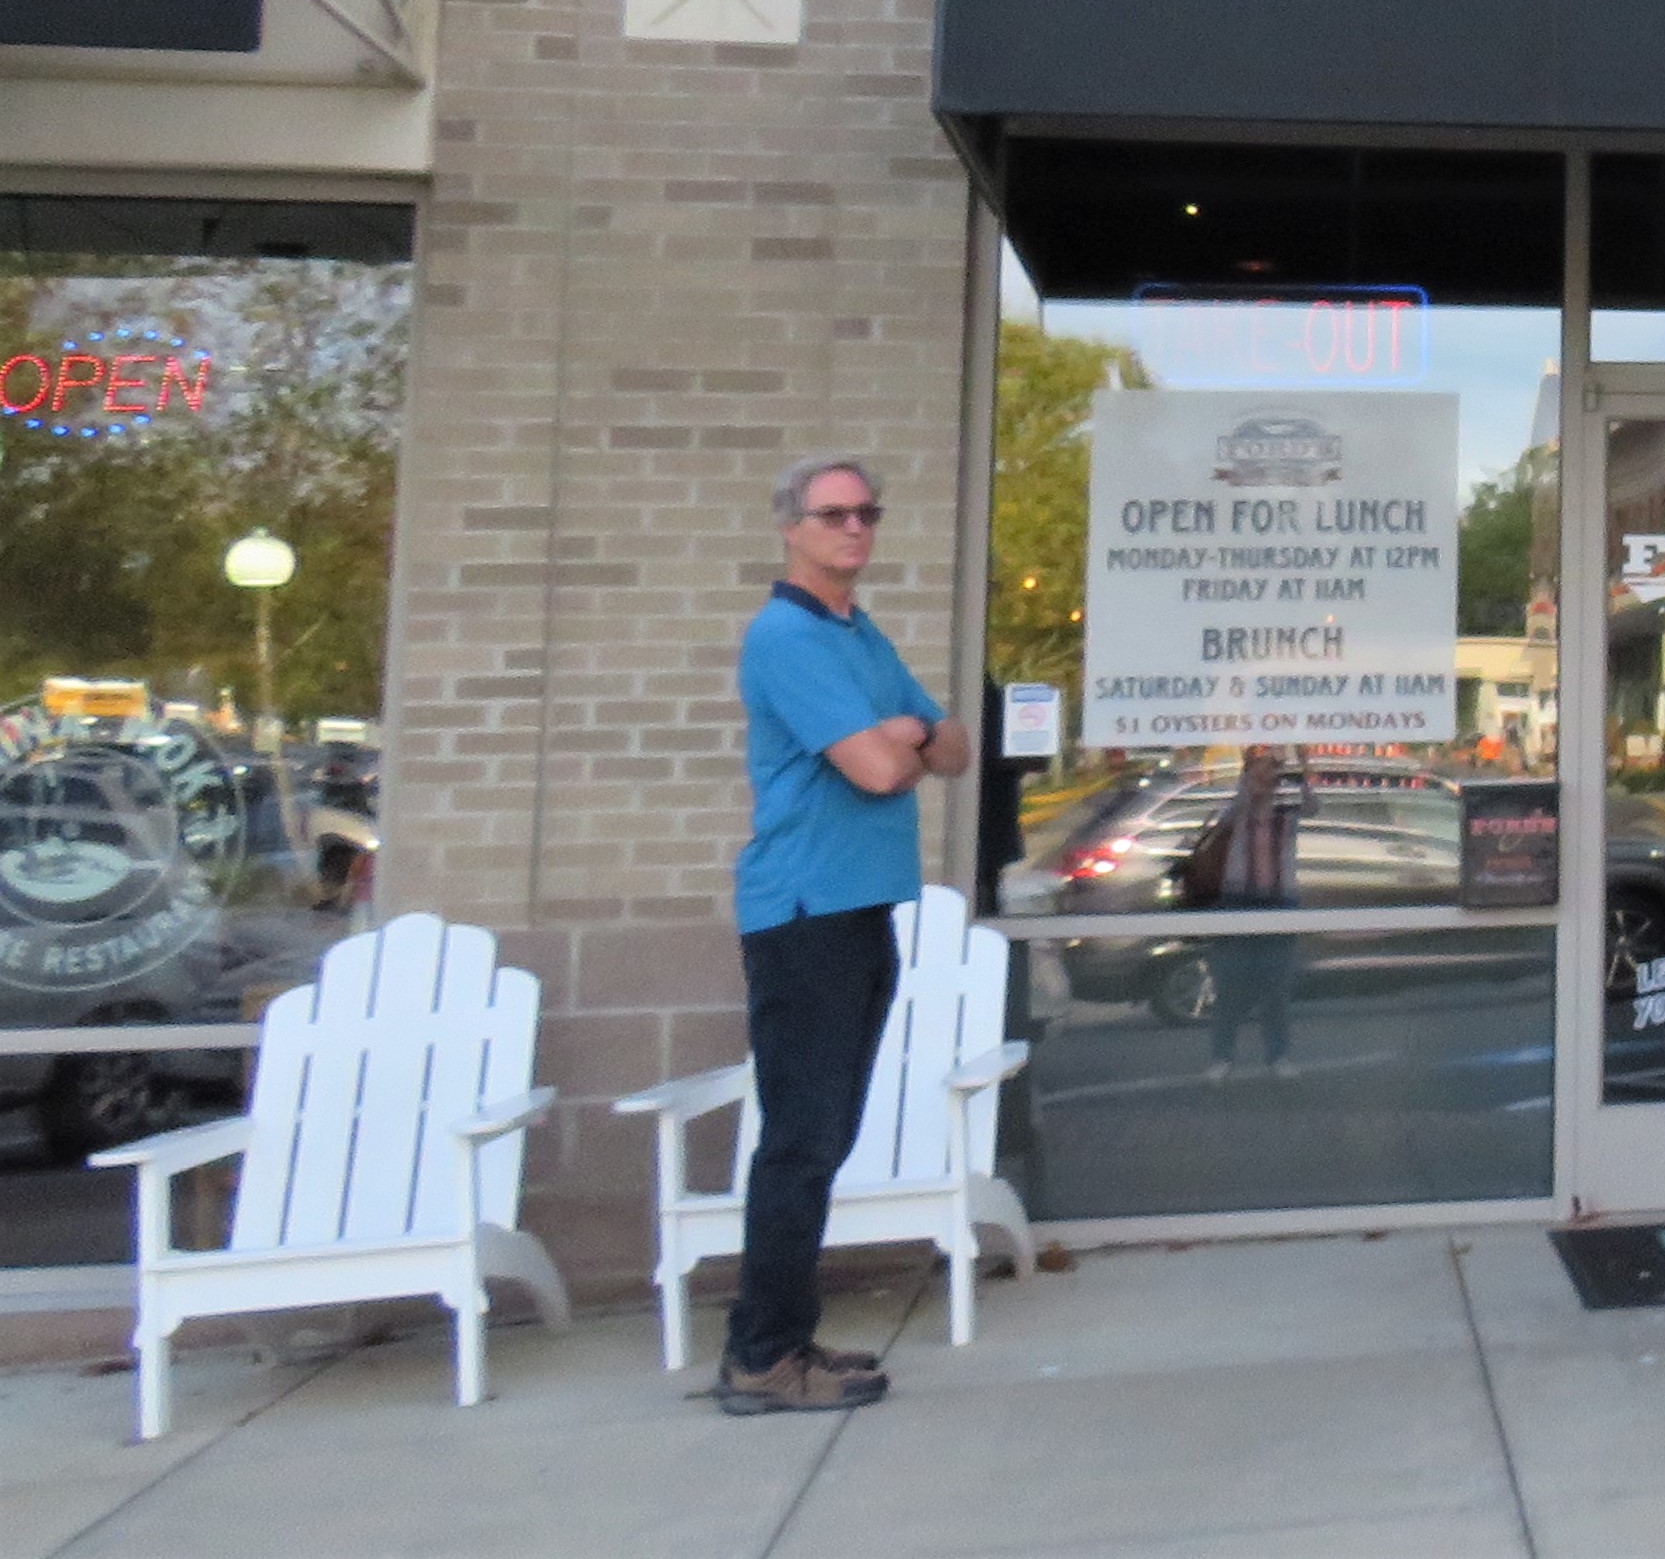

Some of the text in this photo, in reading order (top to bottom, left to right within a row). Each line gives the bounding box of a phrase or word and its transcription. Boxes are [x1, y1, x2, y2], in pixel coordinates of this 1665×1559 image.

[0, 353, 213, 412] OPEN
[1121, 499, 1426, 534] OPEN FOR LUNCH
[1351, 547, 1376, 569] AT
[1386, 547, 1440, 569] 12PM
[1182, 578, 1268, 601] FRIDAY
[1278, 578, 1305, 600] AT
[1202, 627, 1344, 663] BRUNCH
[1096, 675, 1219, 699] SATURDAY
[1256, 675, 1350, 698] SUNDAY
[1359, 674, 1384, 696] AT
[1150, 714, 1252, 732] OYSTERS
[1260, 713, 1298, 731] ON
[1306, 711, 1426, 730] MONDAYS
